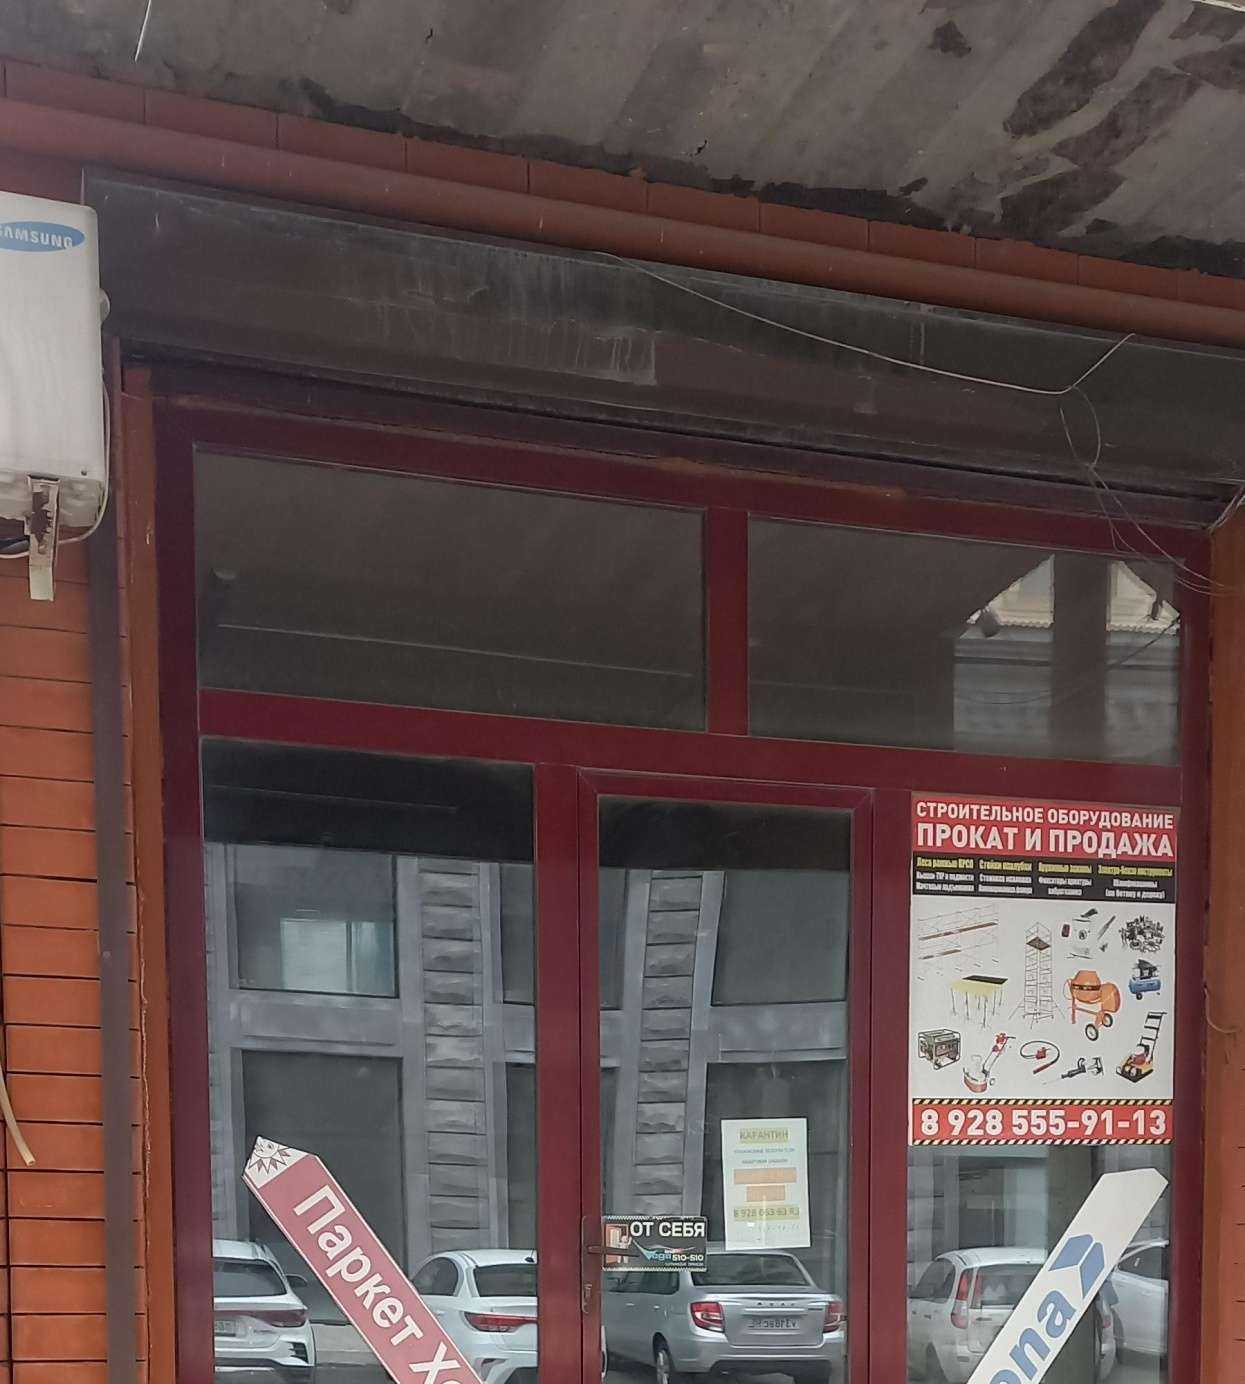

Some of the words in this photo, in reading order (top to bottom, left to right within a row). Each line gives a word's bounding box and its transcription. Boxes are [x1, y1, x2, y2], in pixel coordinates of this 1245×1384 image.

[916, 801, 1044, 824] СТРОИТЕЛЬНОЕ
[1047, 808, 1174, 830] ОБОРУДОВАНИЕ
[916, 822, 1018, 851] ПРОКАТ
[1025, 827, 1042, 852] И
[1049, 828, 1174, 859] ПРОДАЖА
[921, 1108, 939, 1136] 8
[948, 1108, 1004, 1136] 928
[1012, 1108, 1167, 1136] 555-91-13
[629, 1221, 654, 1237] ОТ
[658, 1221, 705, 1237] СЕБЯ
[293, 1185, 424, 1347] Паркет
[672, 1254, 704, 1262] 510-510
